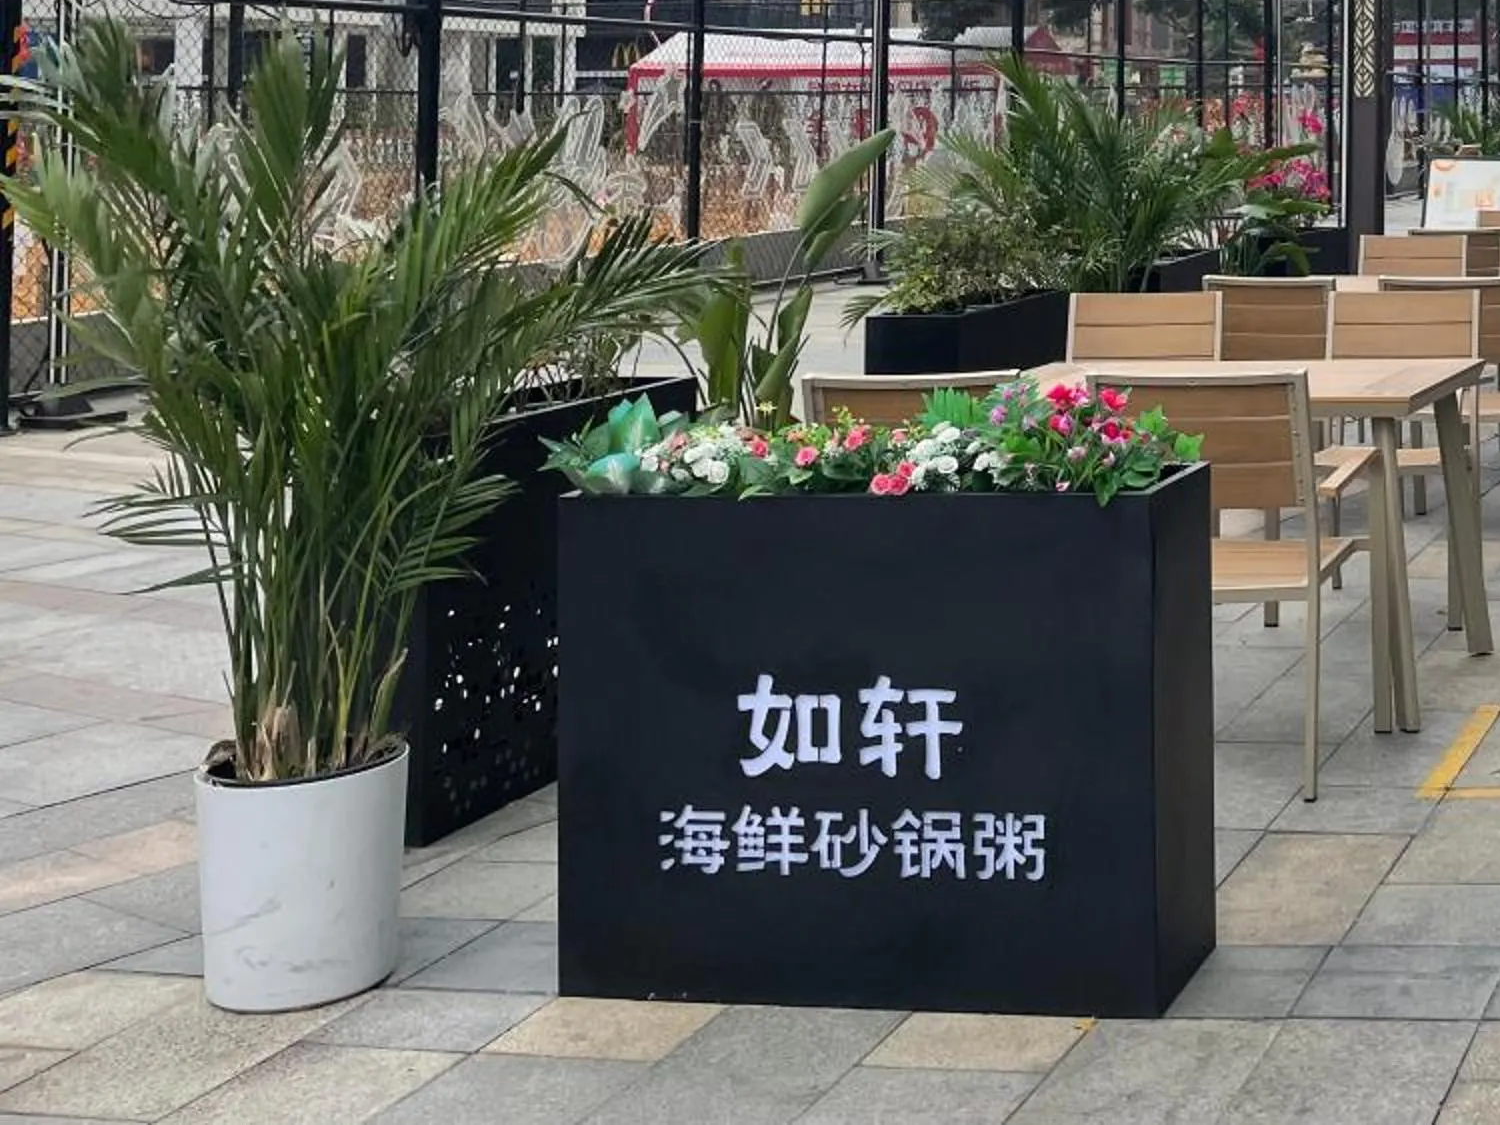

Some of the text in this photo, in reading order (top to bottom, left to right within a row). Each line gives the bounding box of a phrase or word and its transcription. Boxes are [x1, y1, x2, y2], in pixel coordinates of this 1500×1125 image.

[737, 674, 962, 779] 如轩
[658, 803, 1047, 881] 海鲜砂锅粥
